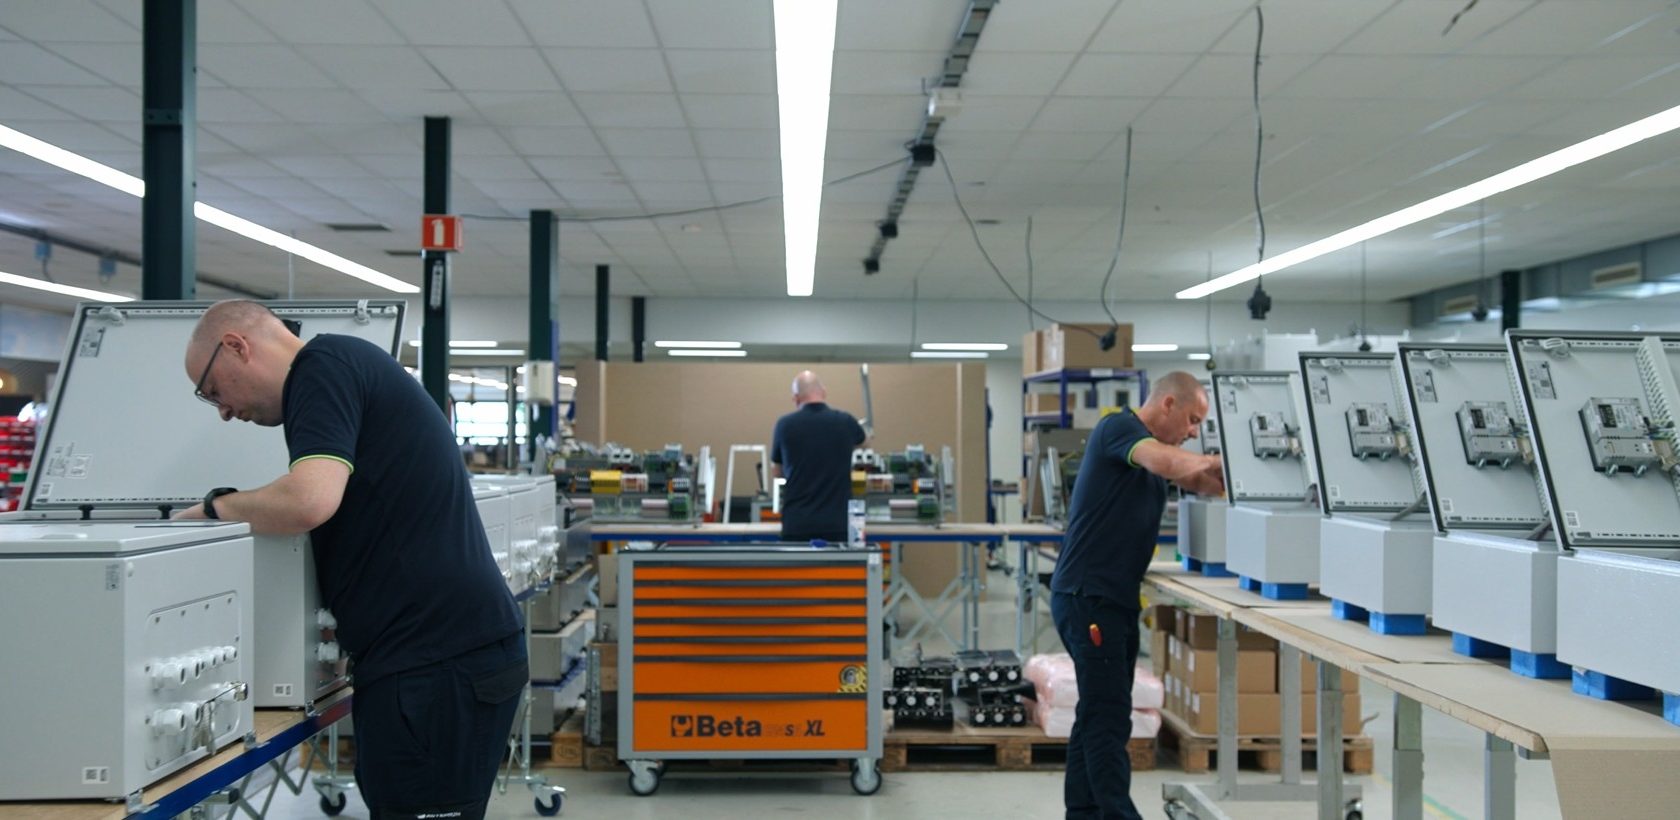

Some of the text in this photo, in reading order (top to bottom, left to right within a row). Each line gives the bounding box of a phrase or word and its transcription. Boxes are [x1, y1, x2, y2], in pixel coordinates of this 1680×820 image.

[432, 219, 444, 247] 1
[697, 715, 762, 737] Beta
[804, 719, 826, 737] XL
